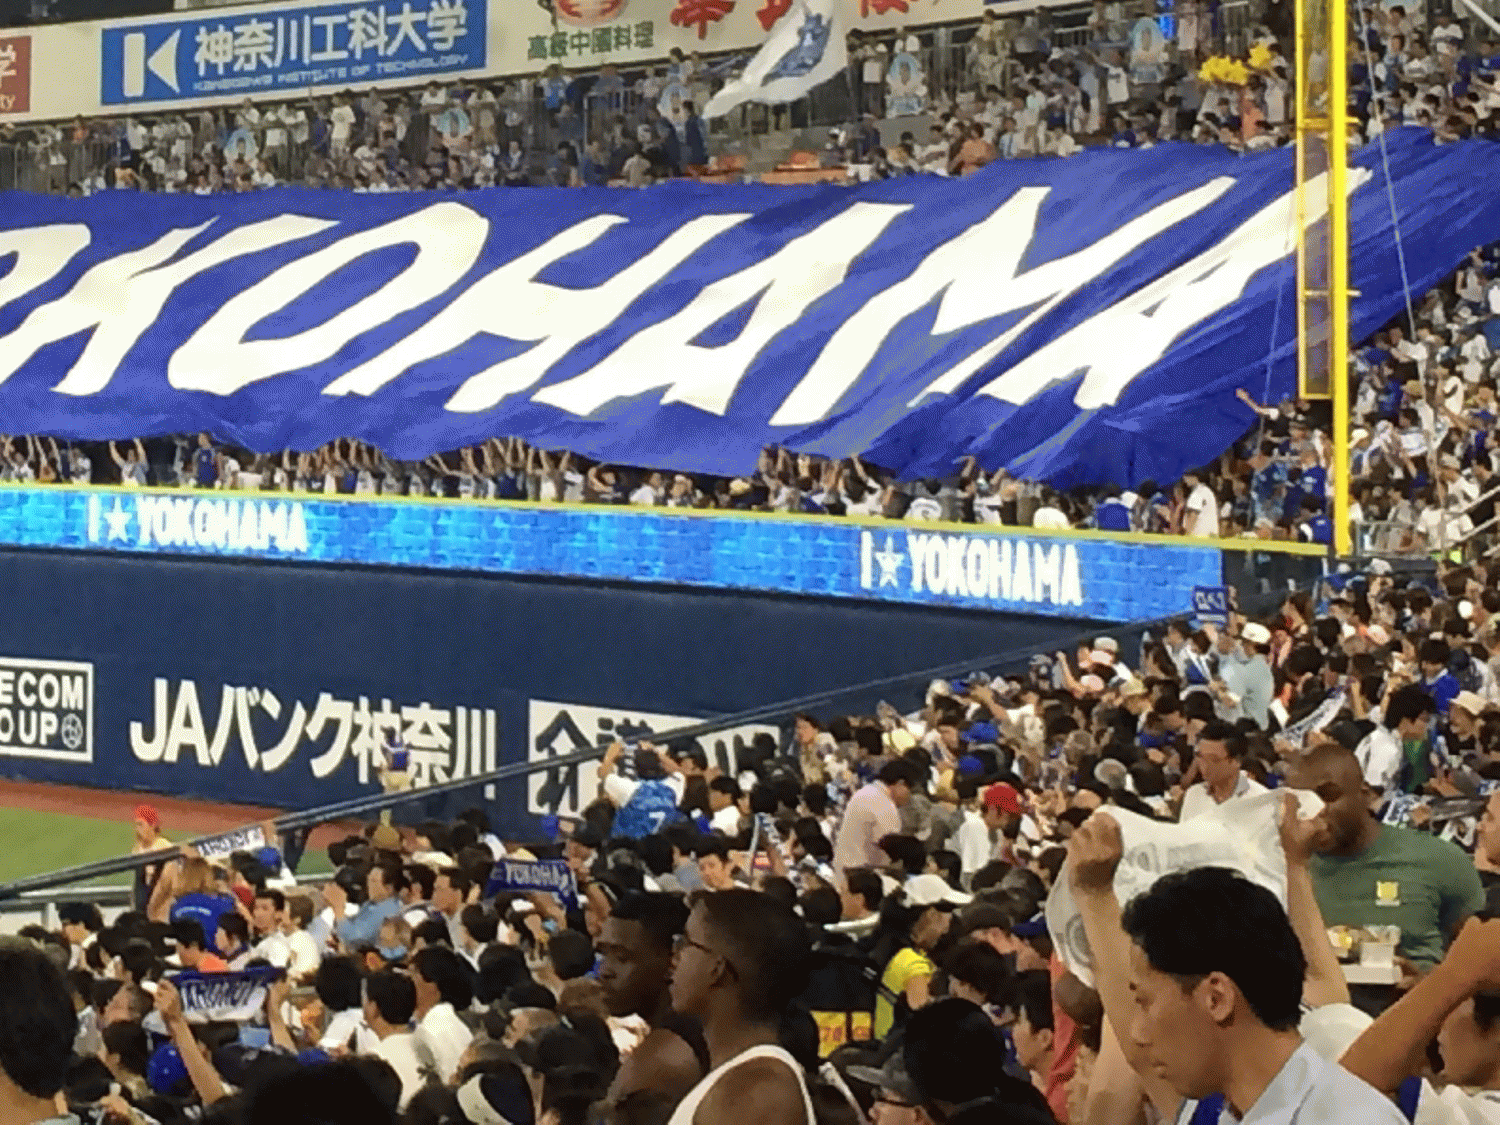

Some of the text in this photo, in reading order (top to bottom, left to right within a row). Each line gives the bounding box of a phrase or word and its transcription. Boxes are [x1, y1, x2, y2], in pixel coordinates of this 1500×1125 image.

[88, 493, 308, 552] I YOKOHAMA
[860, 531, 1084, 607] I YOKOHAMA
